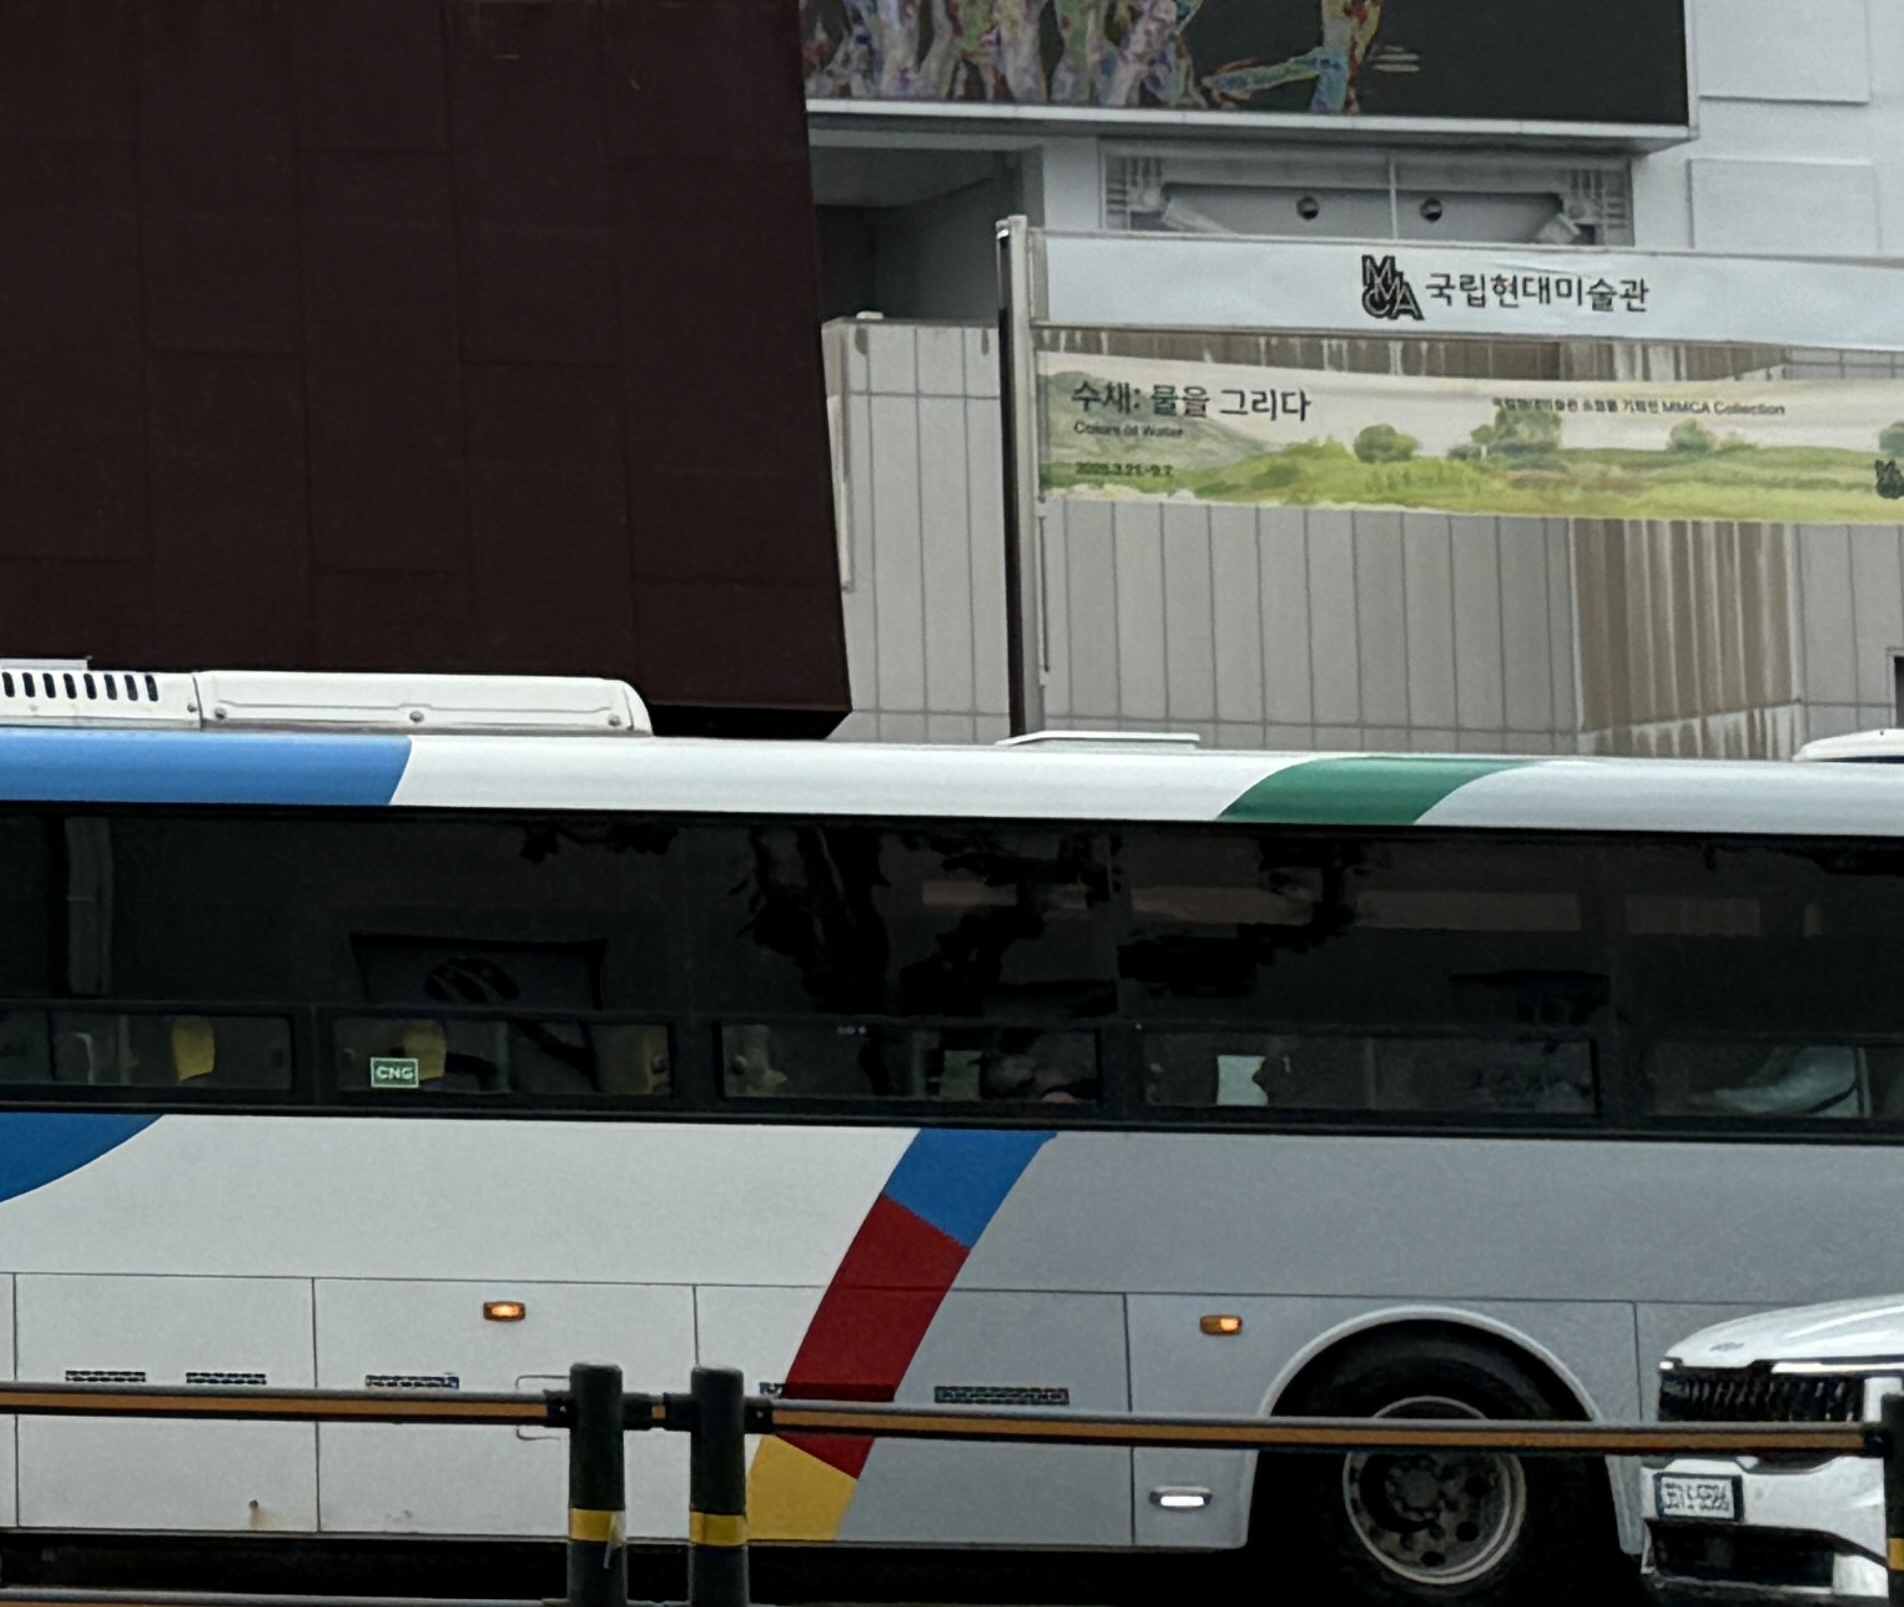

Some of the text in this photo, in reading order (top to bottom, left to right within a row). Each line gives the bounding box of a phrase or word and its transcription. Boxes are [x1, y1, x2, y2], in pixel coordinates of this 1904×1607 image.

[1425, 272, 1650, 313] 국립현대미술관
[1071, 380, 1312, 422] 수채: 물을 그리다
[375, 1065, 414, 1080] CNG
